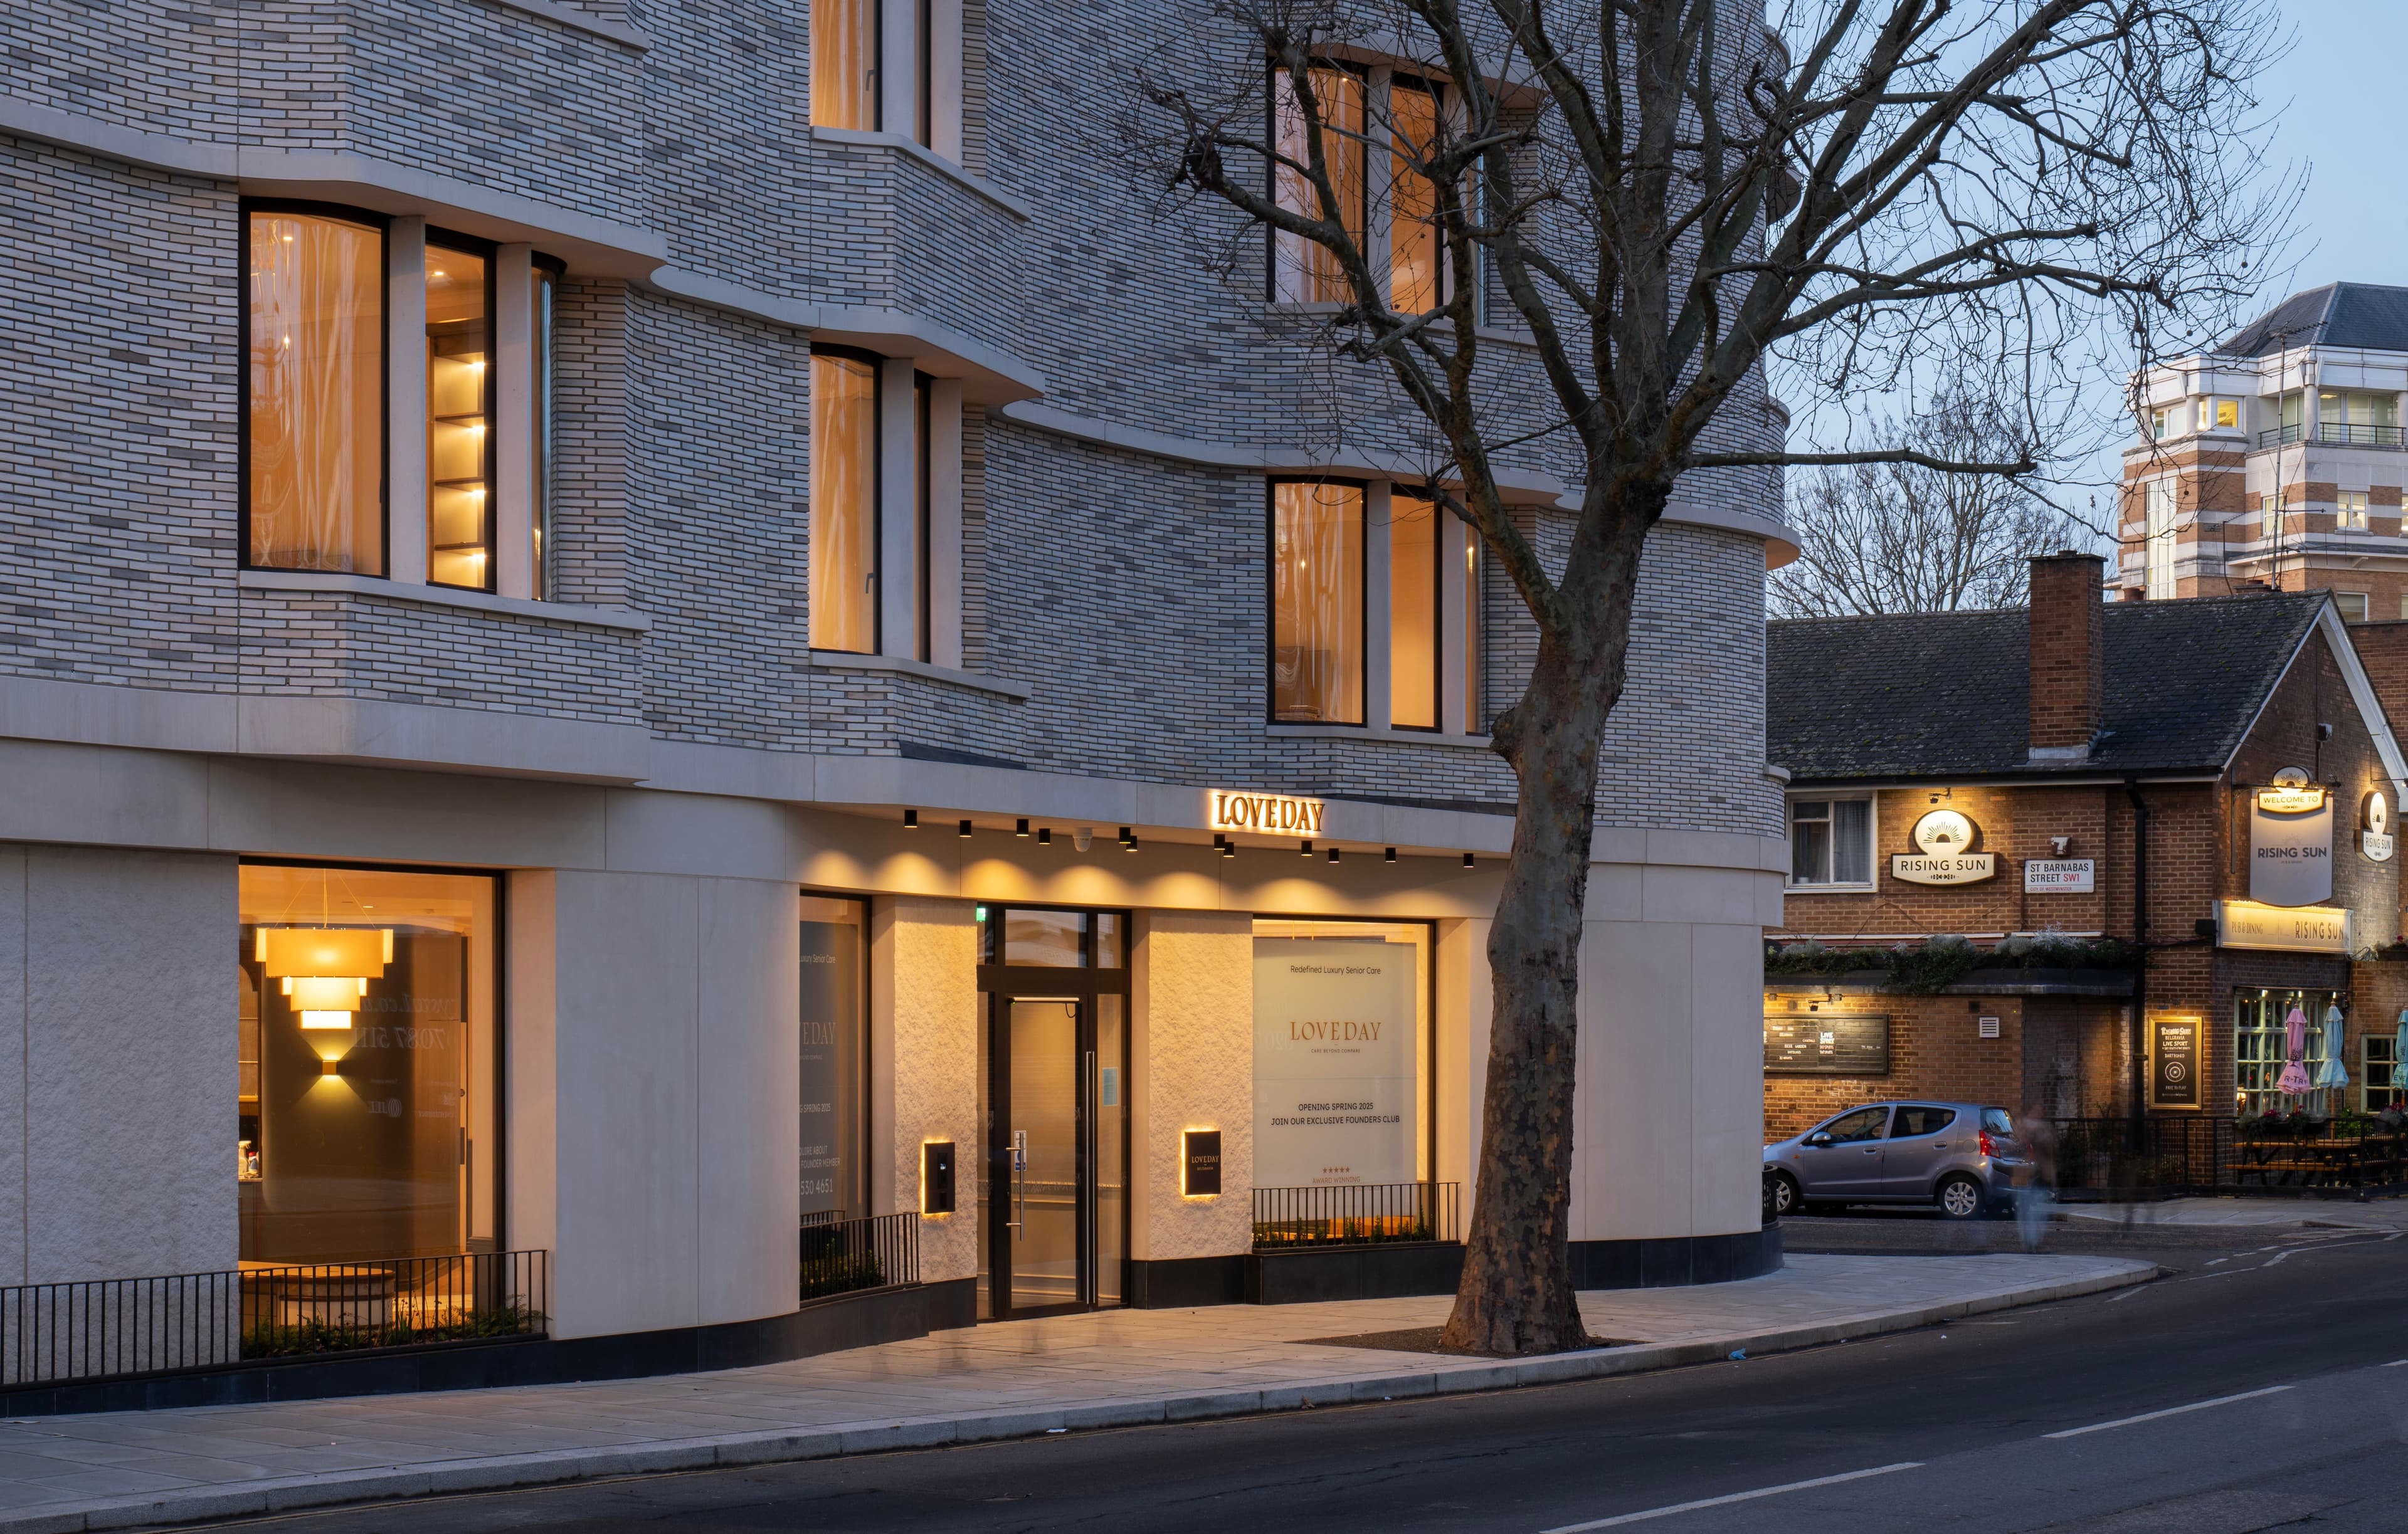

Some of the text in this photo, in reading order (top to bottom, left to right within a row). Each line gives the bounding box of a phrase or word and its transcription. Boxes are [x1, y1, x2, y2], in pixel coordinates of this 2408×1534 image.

[1217, 795, 1326, 832] LOVEDAY
[2365, 837, 2390, 850] RISING SUN
[2258, 847, 2327, 858] RISING SUN
[1901, 859, 1986, 871] RISING SUN
[2030, 863, 2089, 873] ST BARNABAS
[2030, 873, 2080, 883] STREET SW1
[2231, 921, 2241, 933] PUB
[2246, 921, 2263, 934] DINING
[2295, 921, 2344, 940] RISING SUN
[1291, 965, 1381, 976] Redefined Luxury Senior Care
[1290, 1021, 1382, 1041] LOVEDAY
[803, 1103, 821, 1113] SPRING
[821, 1103, 832, 1112] 2025
[1298, 1102, 1374, 1111] OPENING SPRING 2025
[1270, 1115, 1400, 1126] JOIN OUR EXCLUSIVE FOUNDERS CLUB
[813, 1145, 828, 1155] ABOUT
[801, 1157, 841, 1169] FOUNDER MEMBER
[1191, 1155, 1219, 1164] LOVEDAY
[816, 1178, 833, 1194] 4651
